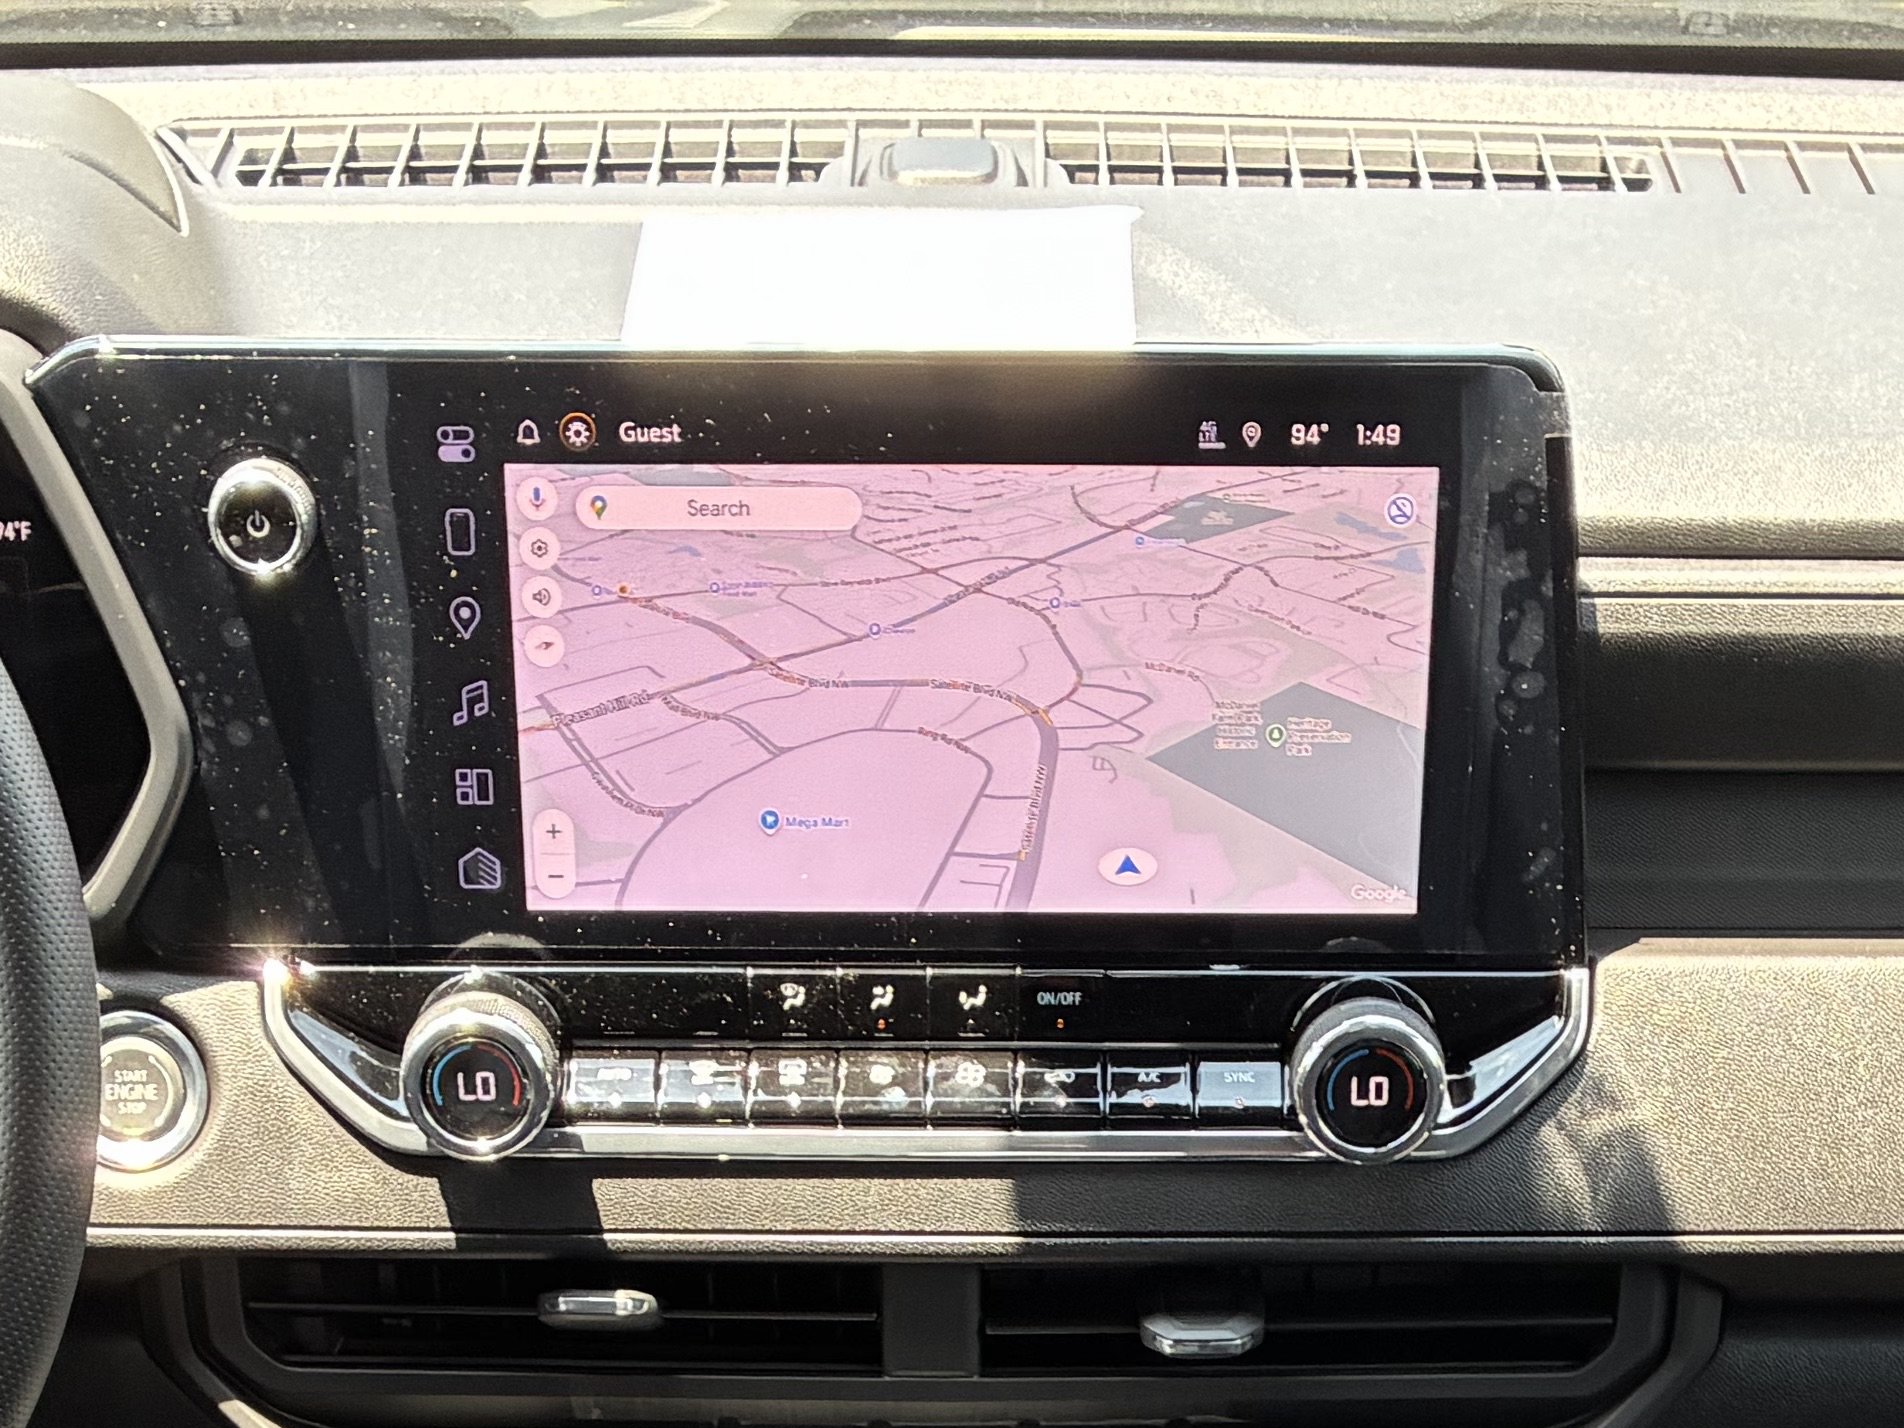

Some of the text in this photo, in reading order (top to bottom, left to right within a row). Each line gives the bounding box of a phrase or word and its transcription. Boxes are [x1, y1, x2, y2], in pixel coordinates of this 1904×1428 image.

[619, 421, 681, 445] Guest
[1291, 423, 1330, 446] 94°
[1356, 423, 1401, 446] 1:49
[687, 498, 750, 519] Search
[784, 816, 850, 831] Mega Mart
[1350, 885, 1407, 903] Google
[1037, 991, 1082, 1007] ON/OFF
[114, 1069, 148, 1082] START
[1137, 1071, 1161, 1083] A/C
[1223, 1071, 1256, 1083] SYNC
[105, 1083, 158, 1101] ENGINE
[458, 1072, 496, 1101] LO
[1351, 1077, 1389, 1107] LO
[118, 1101, 147, 1115] STOP
